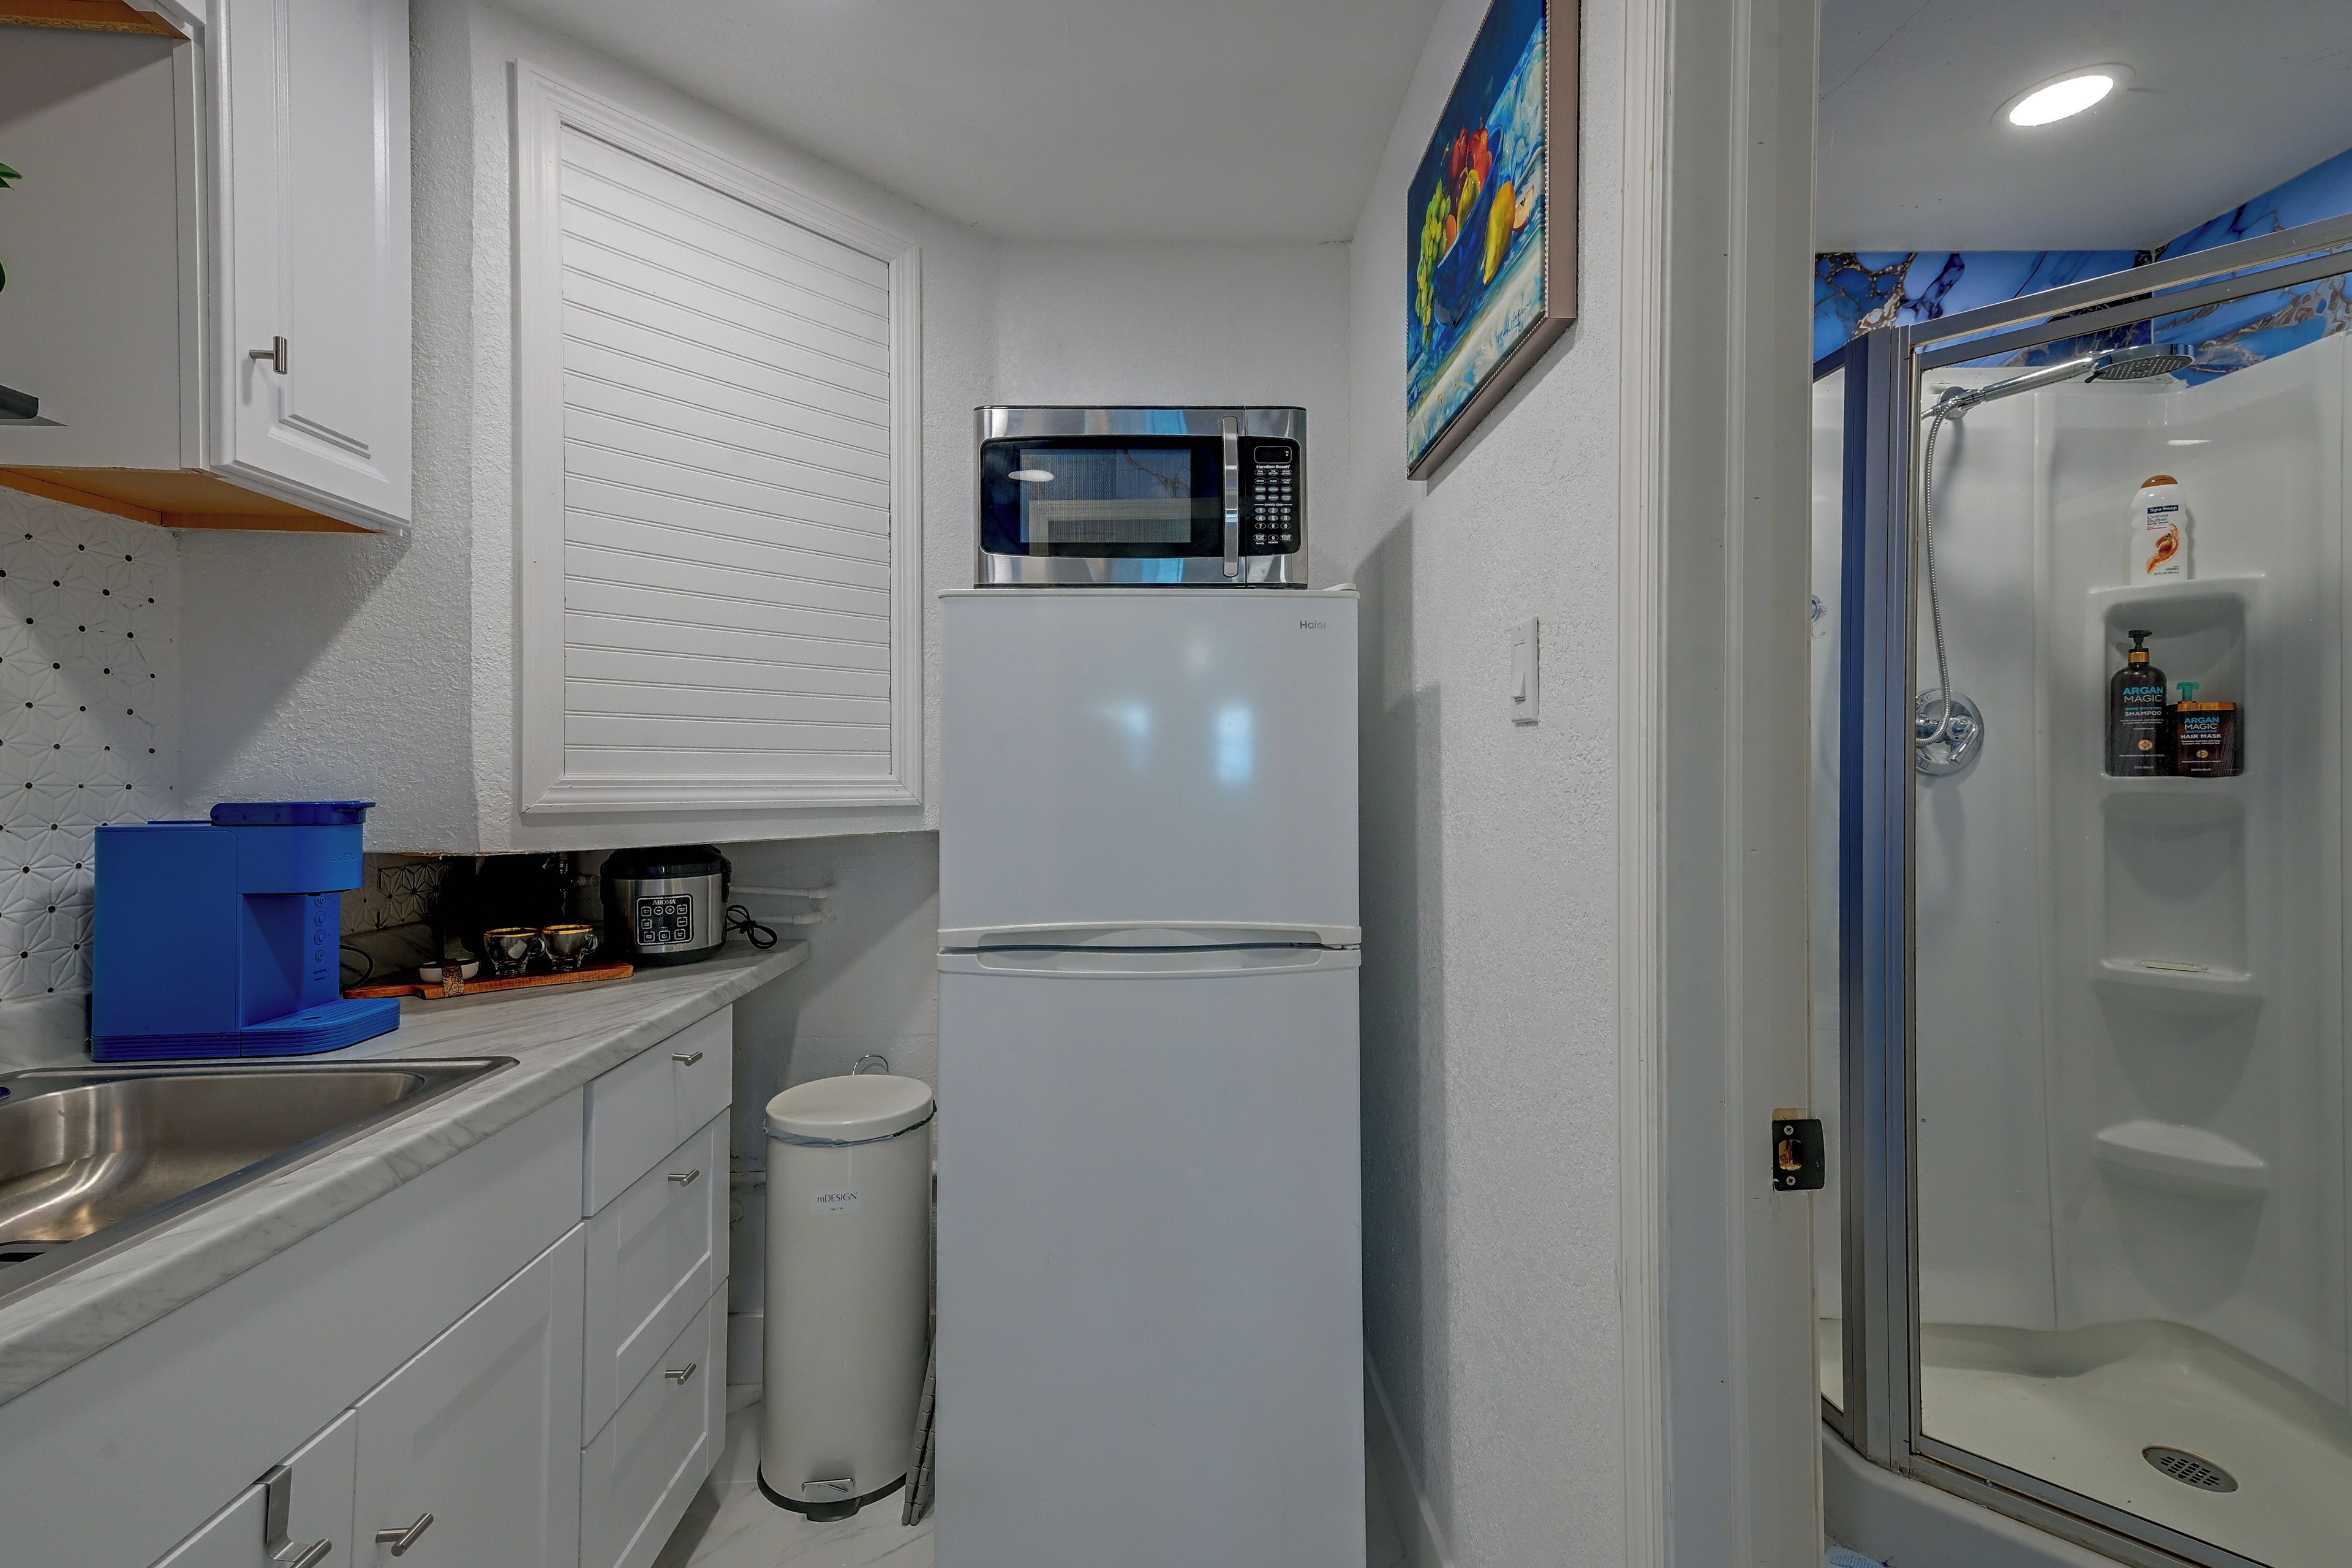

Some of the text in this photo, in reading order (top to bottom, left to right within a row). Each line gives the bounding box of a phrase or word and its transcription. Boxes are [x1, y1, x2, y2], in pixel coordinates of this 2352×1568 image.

[1300, 620, 1327, 629] Haier
[2123, 687, 2163, 695] ARGAN
[2124, 695, 2162, 703] MAGIC
[818, 1193, 857, 1202] mDESIGN
